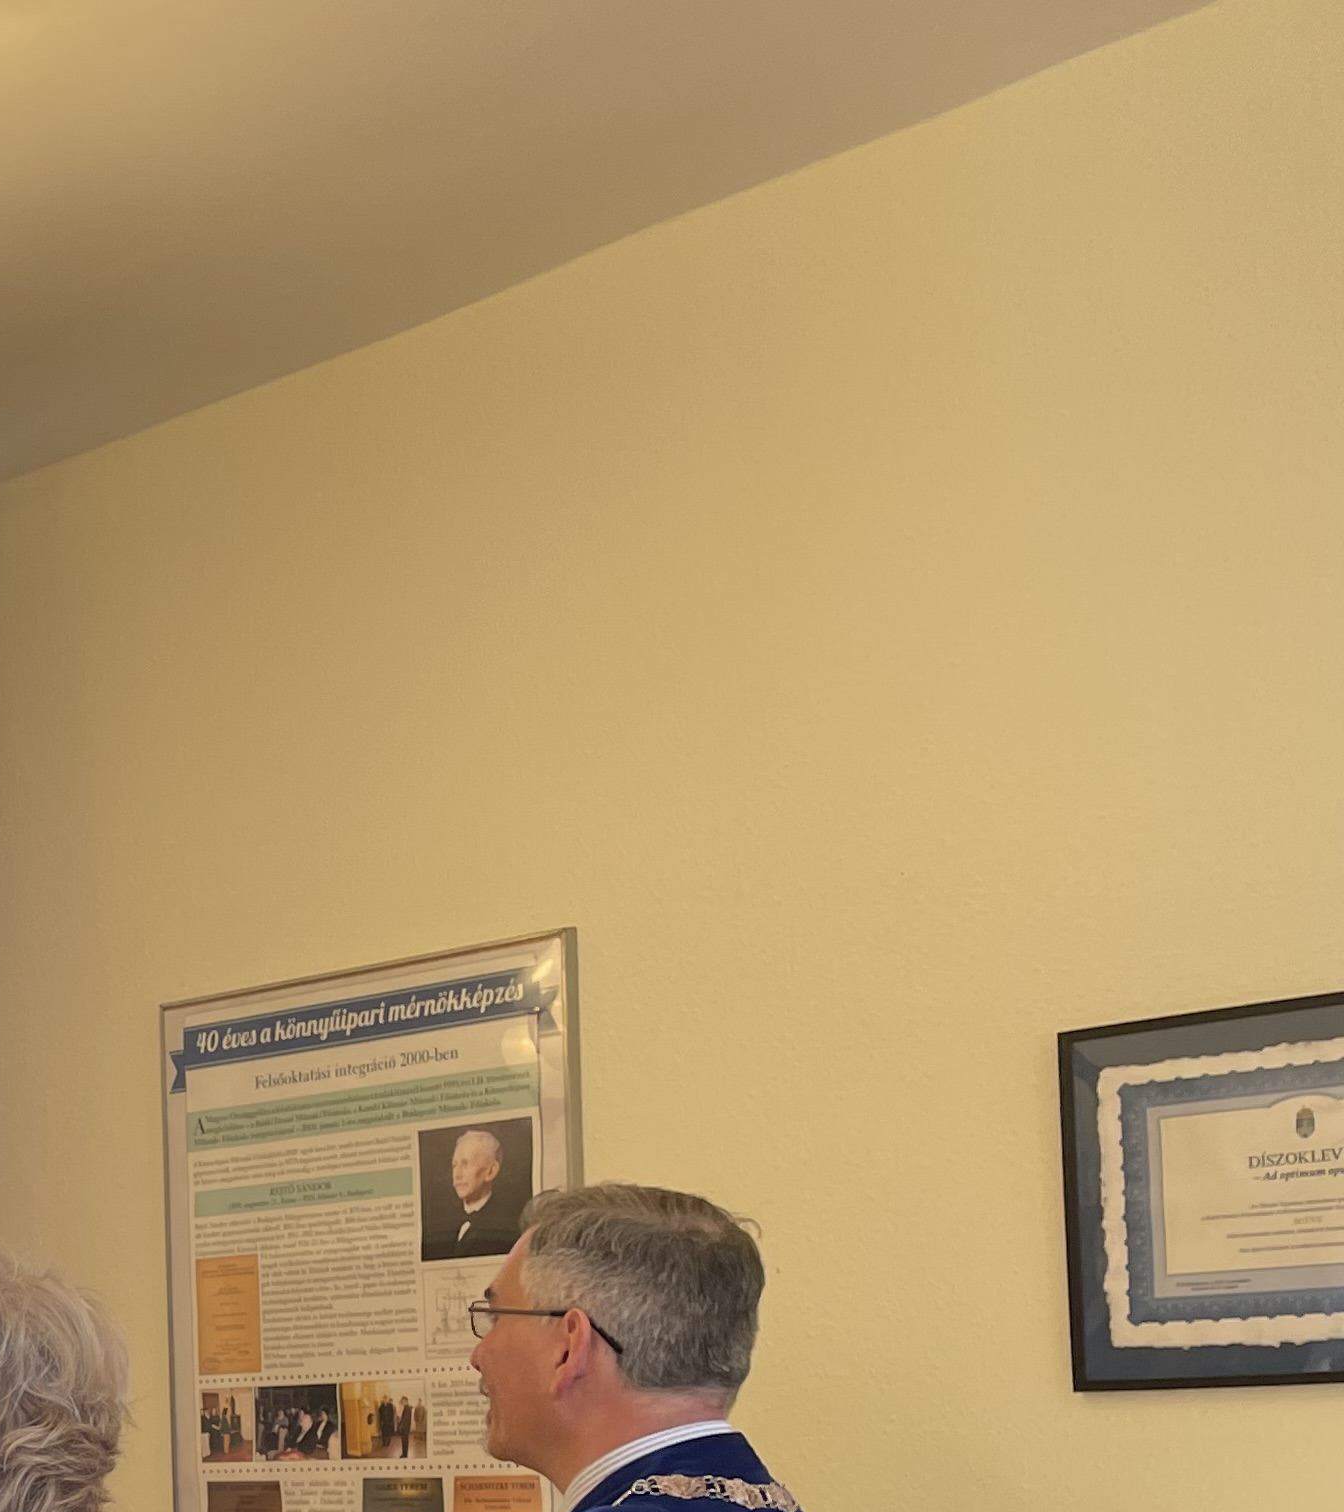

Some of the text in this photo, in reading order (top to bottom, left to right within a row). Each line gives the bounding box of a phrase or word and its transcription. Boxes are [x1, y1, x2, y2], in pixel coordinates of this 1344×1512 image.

[196, 980, 524, 1055] 40 éves a könnyűipari mérnökképzés
[255, 1047, 459, 1090] Felsőoktatási integráció 2000-ben
